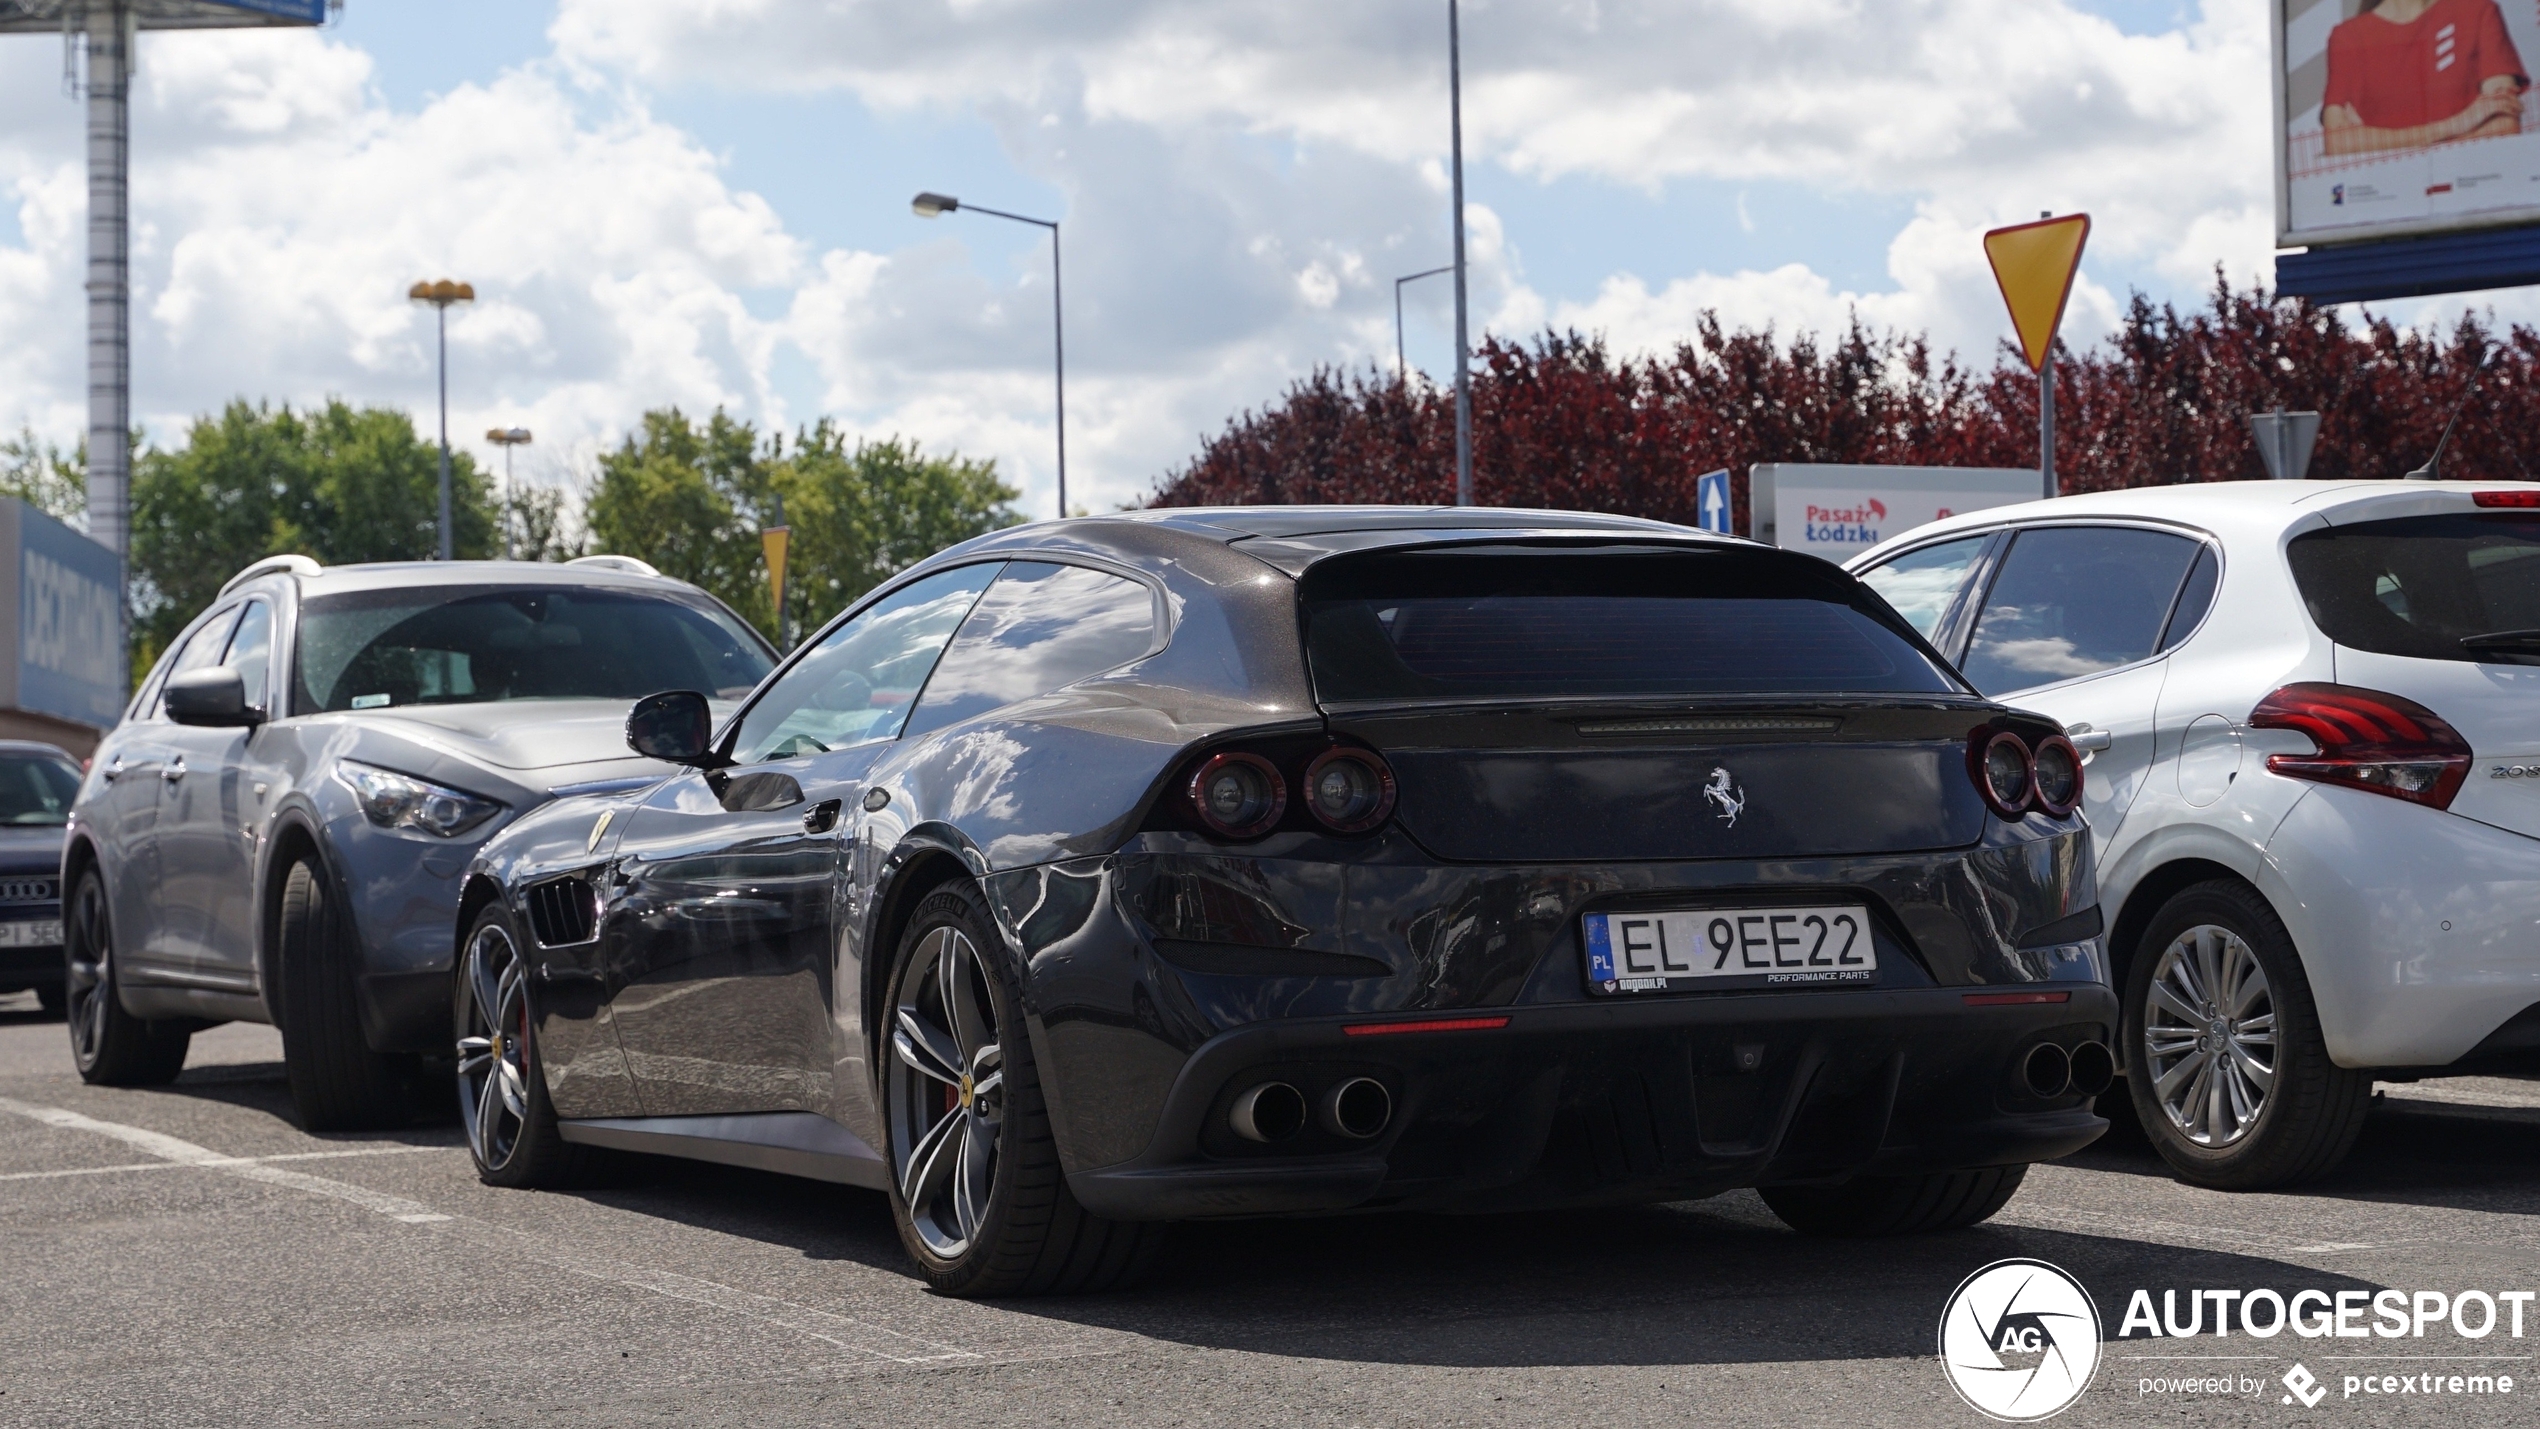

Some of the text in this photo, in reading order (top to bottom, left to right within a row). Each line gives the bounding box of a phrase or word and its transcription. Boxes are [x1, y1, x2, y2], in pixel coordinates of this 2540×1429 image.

[1806, 504, 1866, 522] Pasaż
[1806, 523, 1878, 542] Łódzki
[2491, 764, 2540, 779] 208
[1620, 914, 1864, 973] EL 9EE22
[1592, 955, 1611, 970] PL
[1767, 971, 1870, 983] PERFORMANCE PARTS
